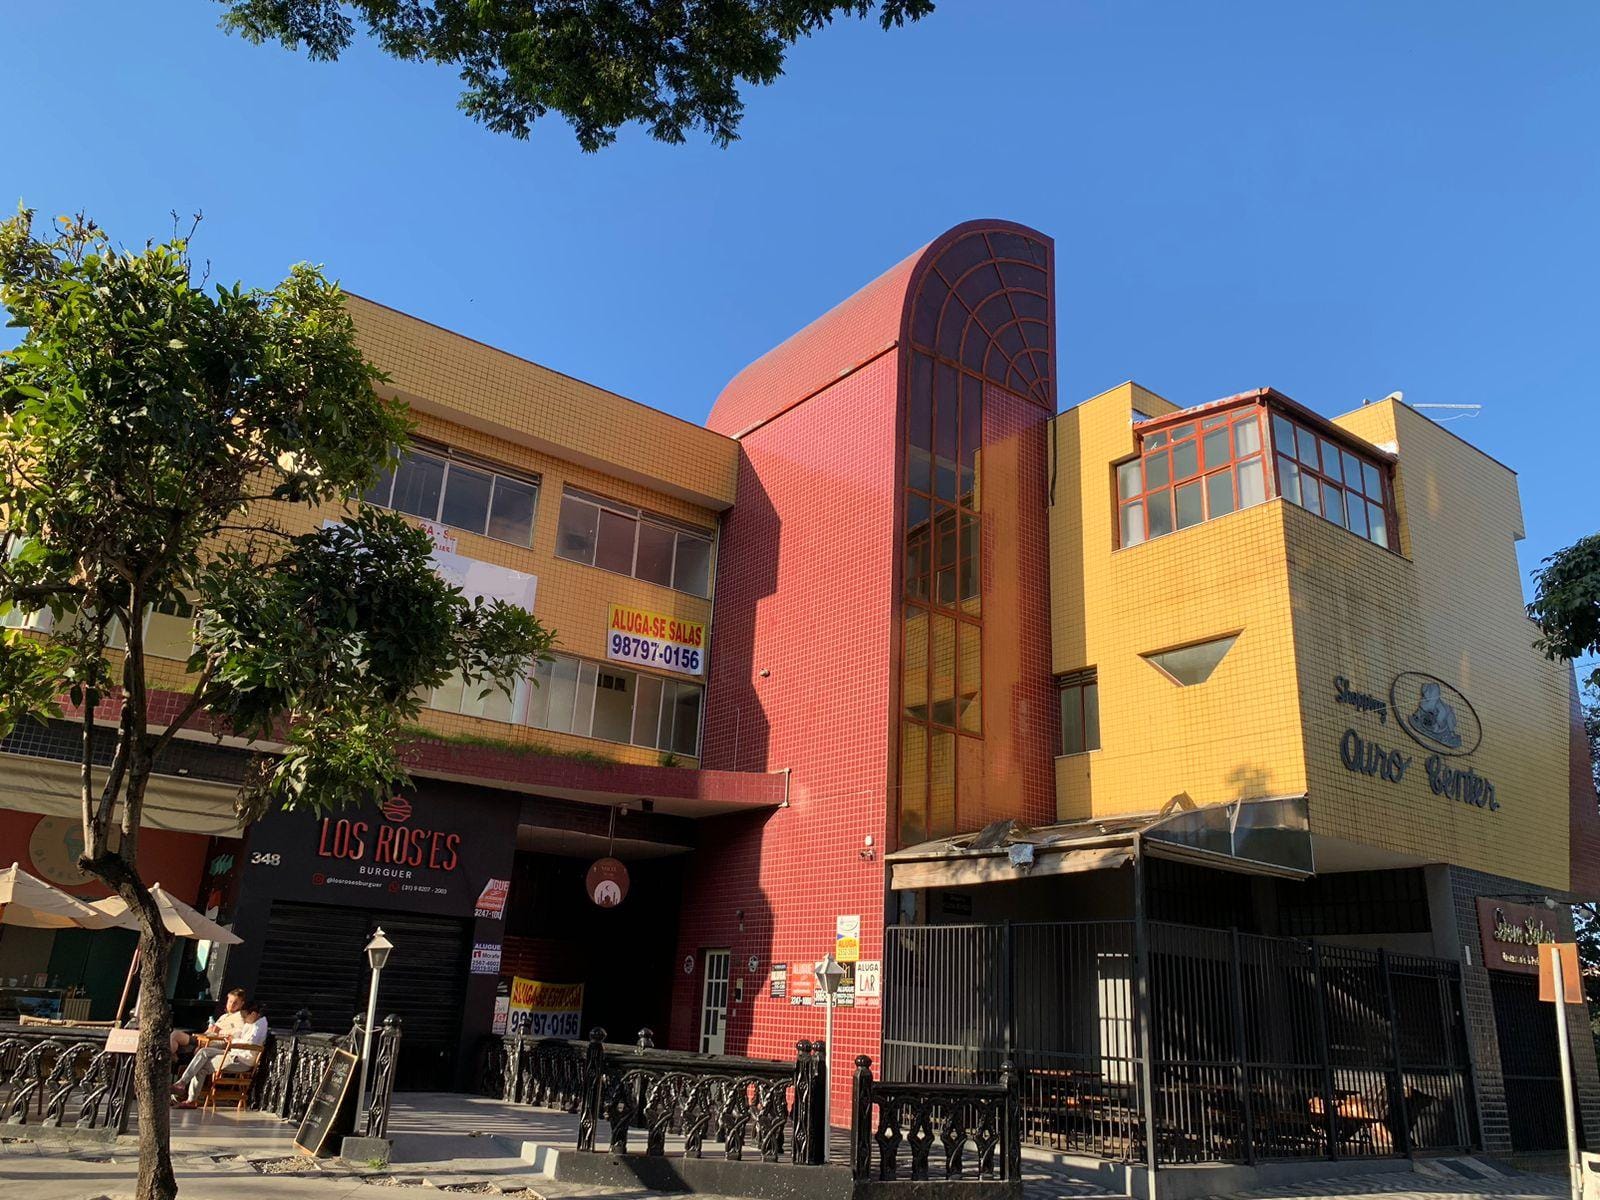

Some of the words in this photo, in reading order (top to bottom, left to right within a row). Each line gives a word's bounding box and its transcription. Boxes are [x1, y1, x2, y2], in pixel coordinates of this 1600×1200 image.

[612, 608, 666, 639] ALUGA-SE
[668, 620, 702, 646] SALAS
[612, 633, 699, 670] 98797-0156
[1340, 729, 1413, 784] Ouro
[318, 817, 368, 861] LOS
[374, 825, 461, 872] ROS'ES
[251, 852, 281, 866] 348
[359, 865, 413, 879] BURGUER
[326, 877, 382, 888] @losrosesburguer
[857, 963, 879, 972] ALUGA
[859, 974, 875, 992] LAR
